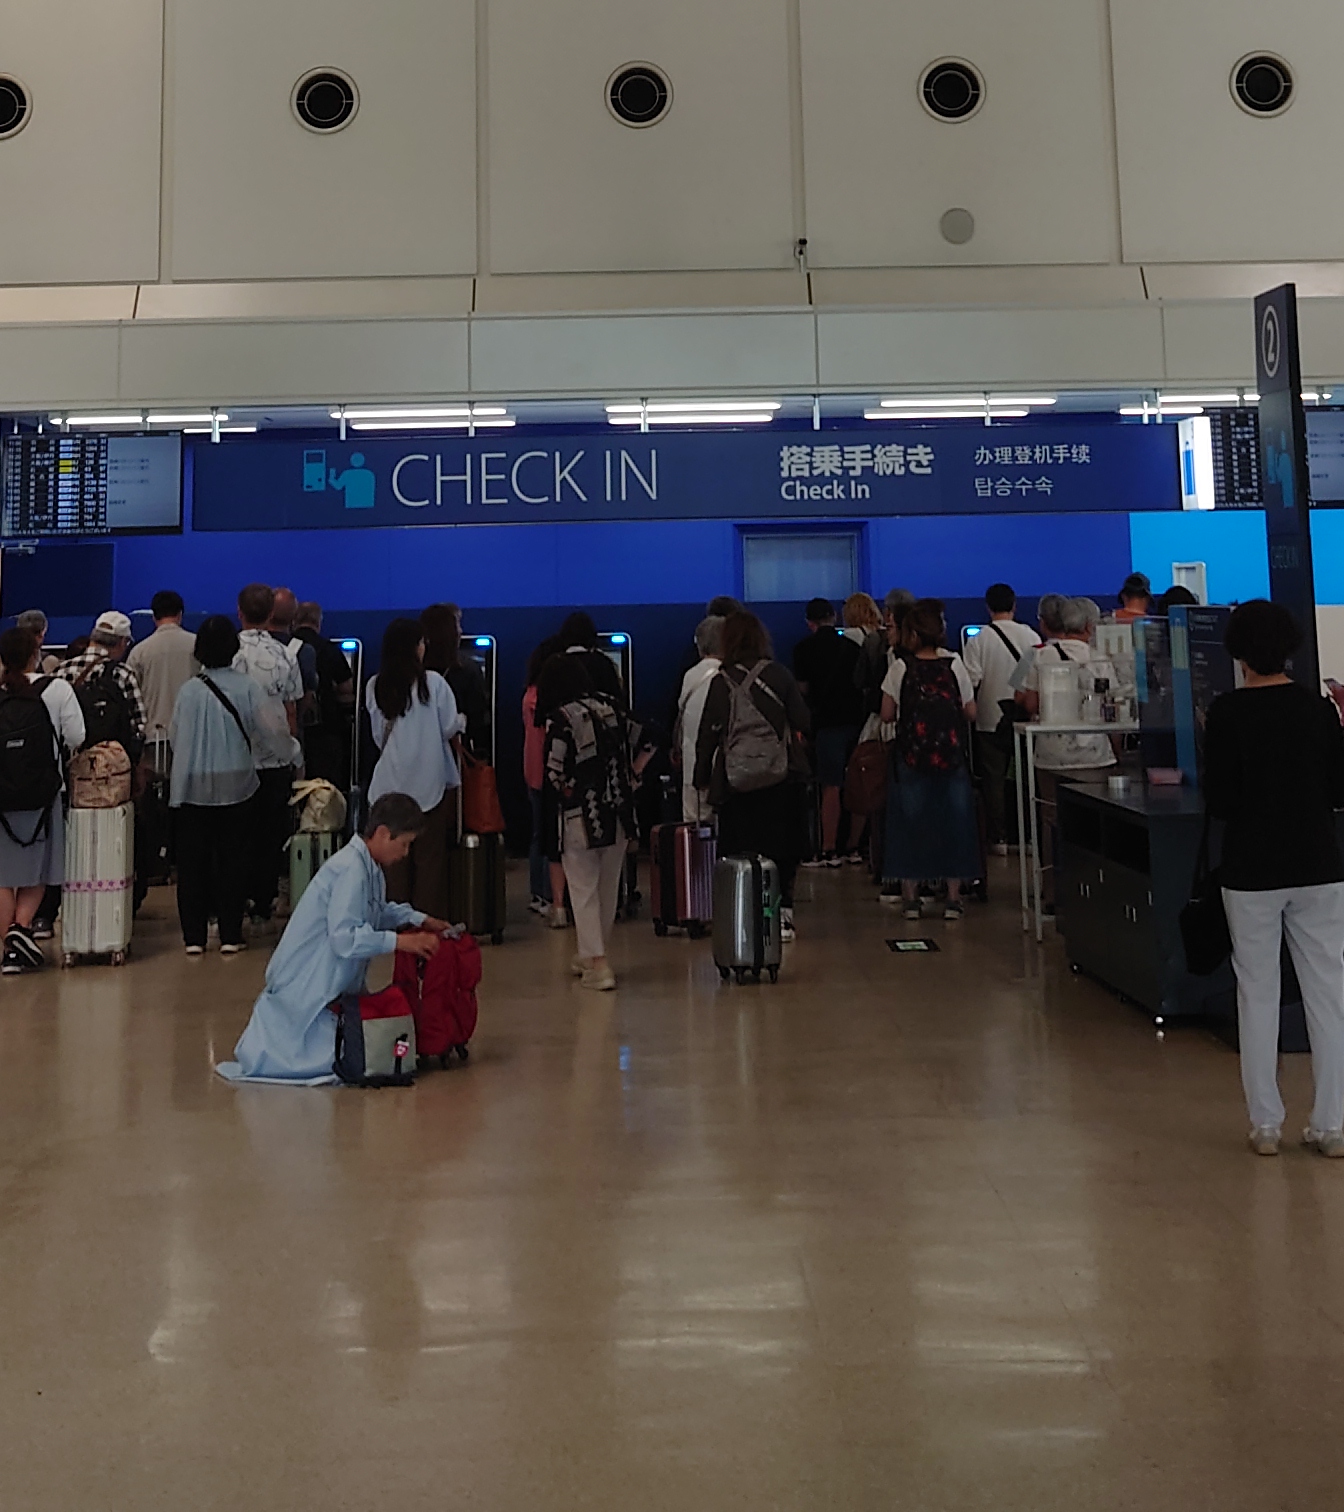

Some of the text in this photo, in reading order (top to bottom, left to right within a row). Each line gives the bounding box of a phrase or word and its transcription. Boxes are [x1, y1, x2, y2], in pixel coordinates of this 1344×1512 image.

[780, 444, 935, 477] 搭乗手続き
[974, 444, 1091, 465] 办理登机手续
[391, 449, 658, 508] CHECK IN
[975, 476, 1054, 496] 탑승수속
[781, 480, 871, 500] Check In
